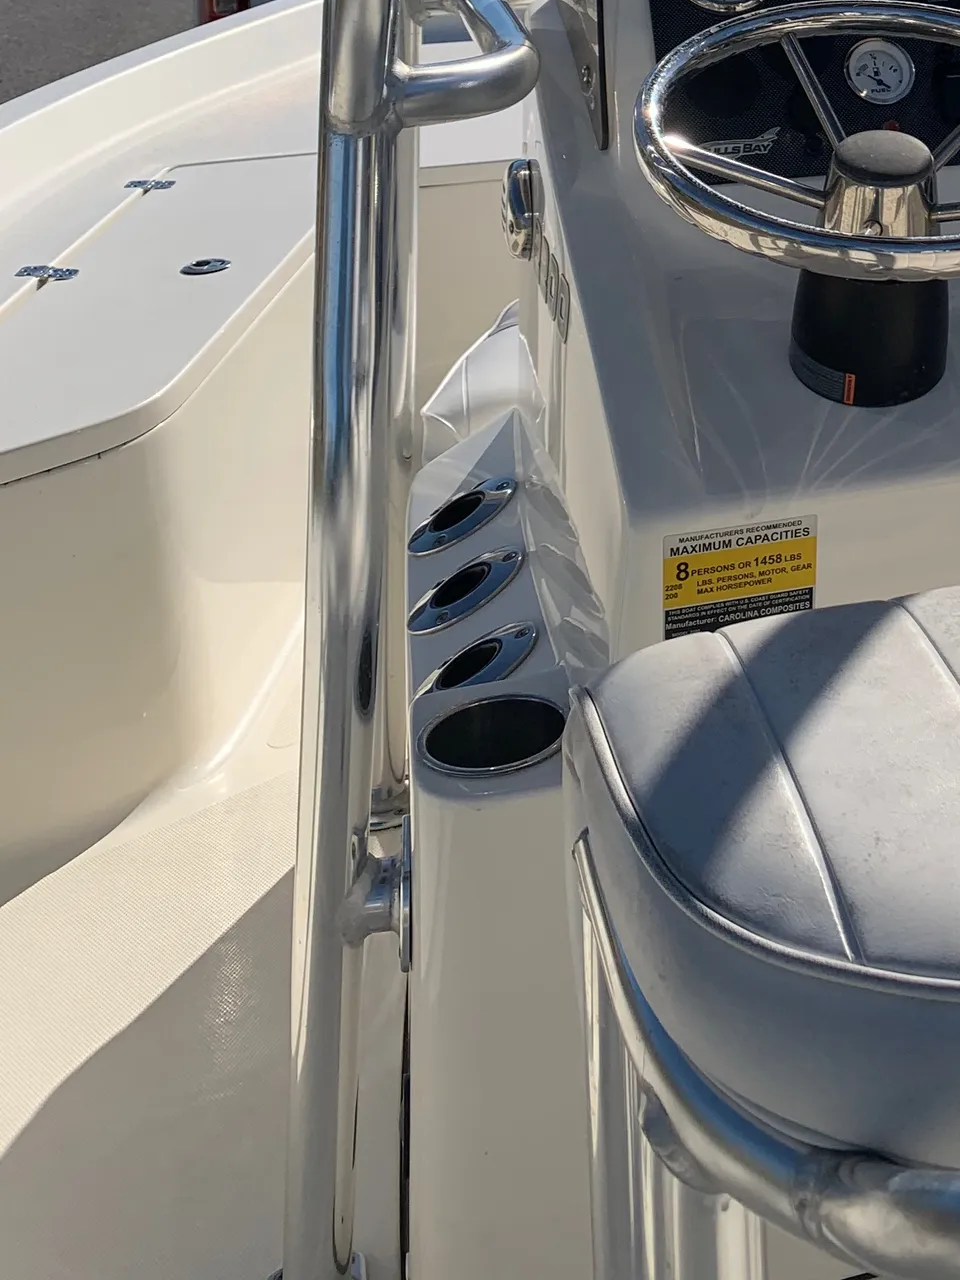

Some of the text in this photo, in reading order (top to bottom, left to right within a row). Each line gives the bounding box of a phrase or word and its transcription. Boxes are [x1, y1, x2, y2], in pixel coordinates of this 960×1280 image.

[670, 527, 810, 557] MAXIMUM CAPACITIES
[679, 520, 802, 544] MANUFACTURERS RECOMMENDED
[676, 553, 802, 581] 8 PERSONS OR 1458 LBS
[697, 578, 714, 587] LBS.
[717, 571, 757, 584] PERSONS,
[759, 566, 788, 577] MOTOR,
[790, 563, 812, 572] GEAR
[665, 577, 772, 600] 200 MAX HORSEPOWER
[772, 595, 810, 605] CERTIFICATION
[665, 601, 810, 630] Manufacturer: CAROLINA COMPOSITES
